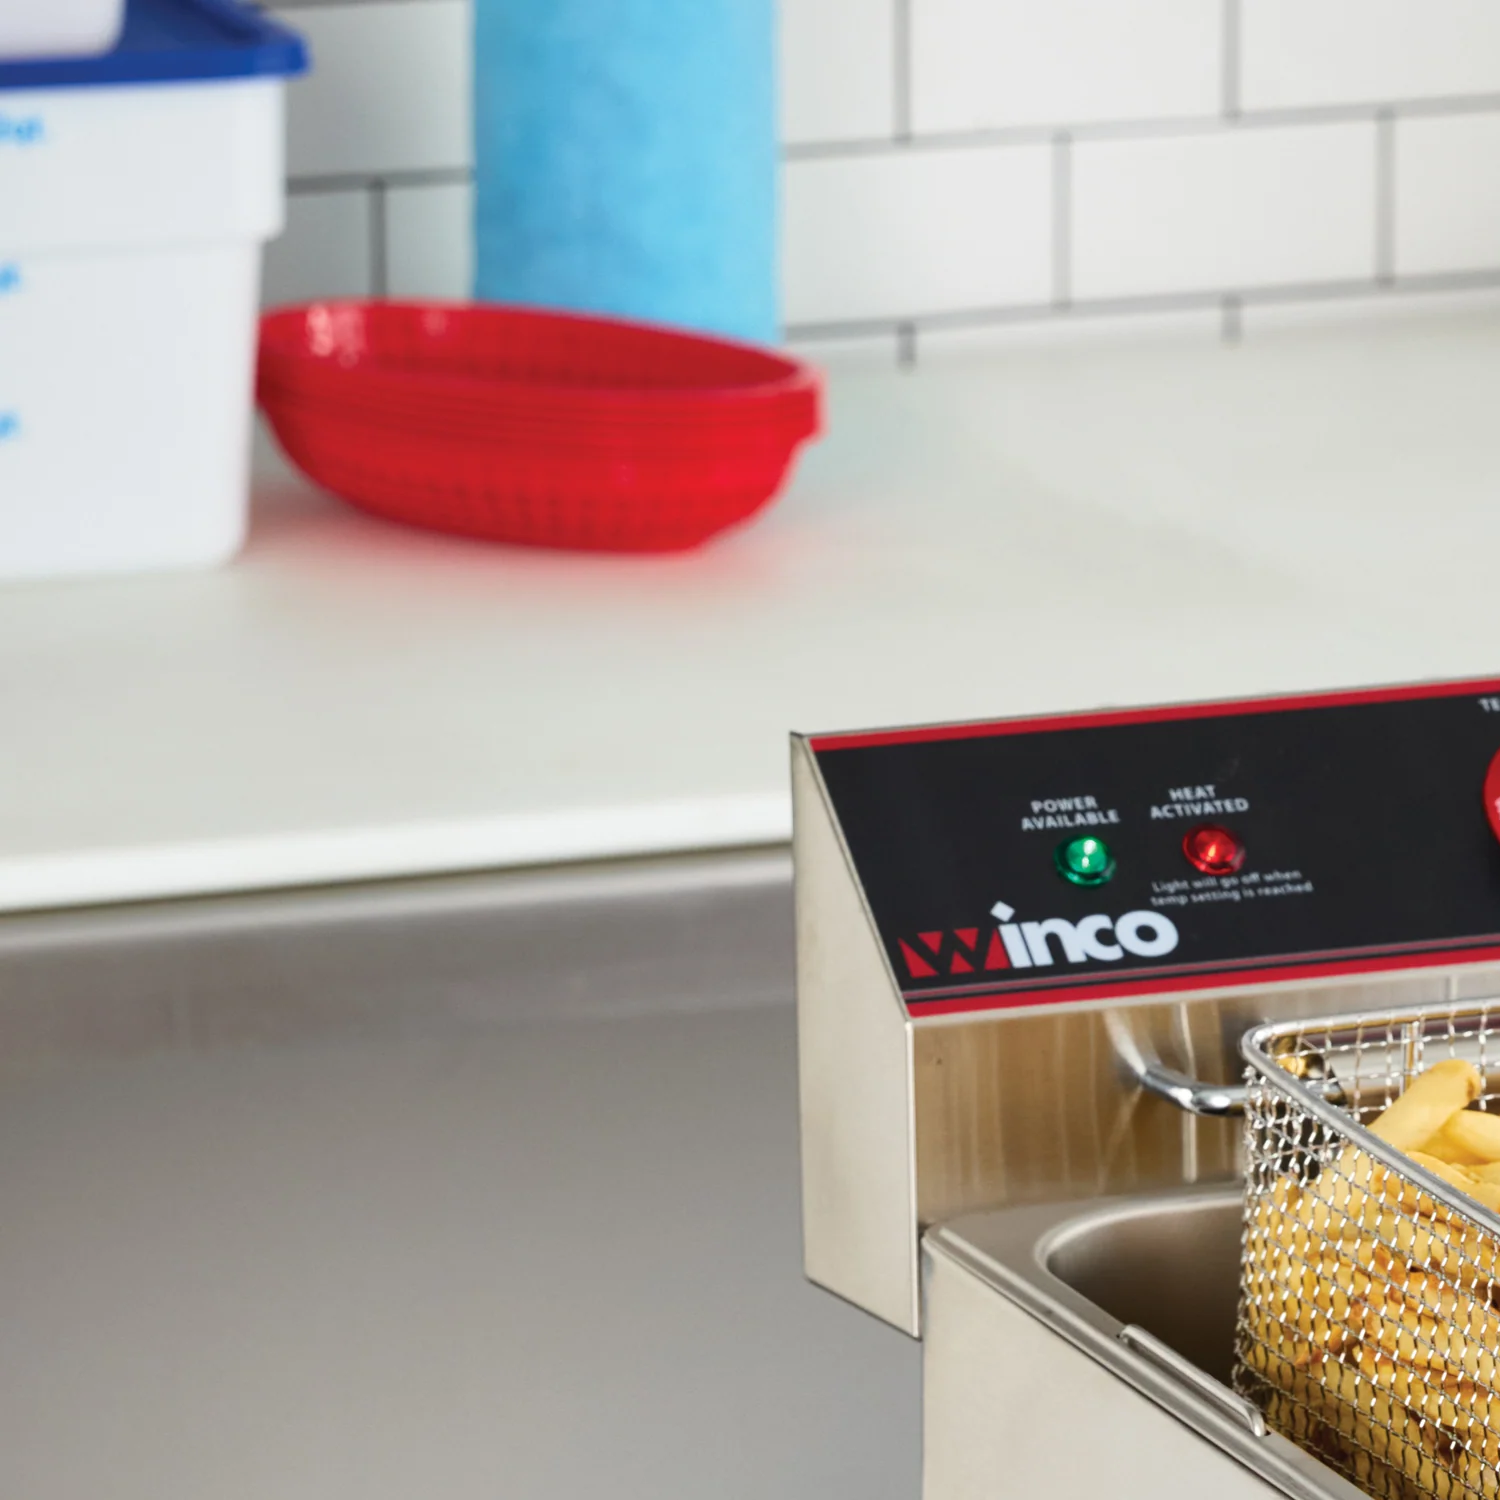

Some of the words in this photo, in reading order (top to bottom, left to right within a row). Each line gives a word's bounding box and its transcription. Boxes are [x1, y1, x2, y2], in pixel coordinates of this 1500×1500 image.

[1168, 784, 1216, 802] HEAT
[1030, 795, 1098, 814] POWER
[1150, 797, 1249, 820] ACTIVATED
[1021, 809, 1120, 831] AVAILABLE
[1152, 879, 1190, 893] Light
[1192, 876, 1218, 889] will
[1220, 876, 1239, 889] go
[1241, 872, 1260, 884] off
[1263, 869, 1302, 882] when
[1151, 894, 1188, 907] temp
[1190, 889, 1241, 903] setting
[1243, 888, 1255, 898] is
[1258, 880, 1314, 897] reached
